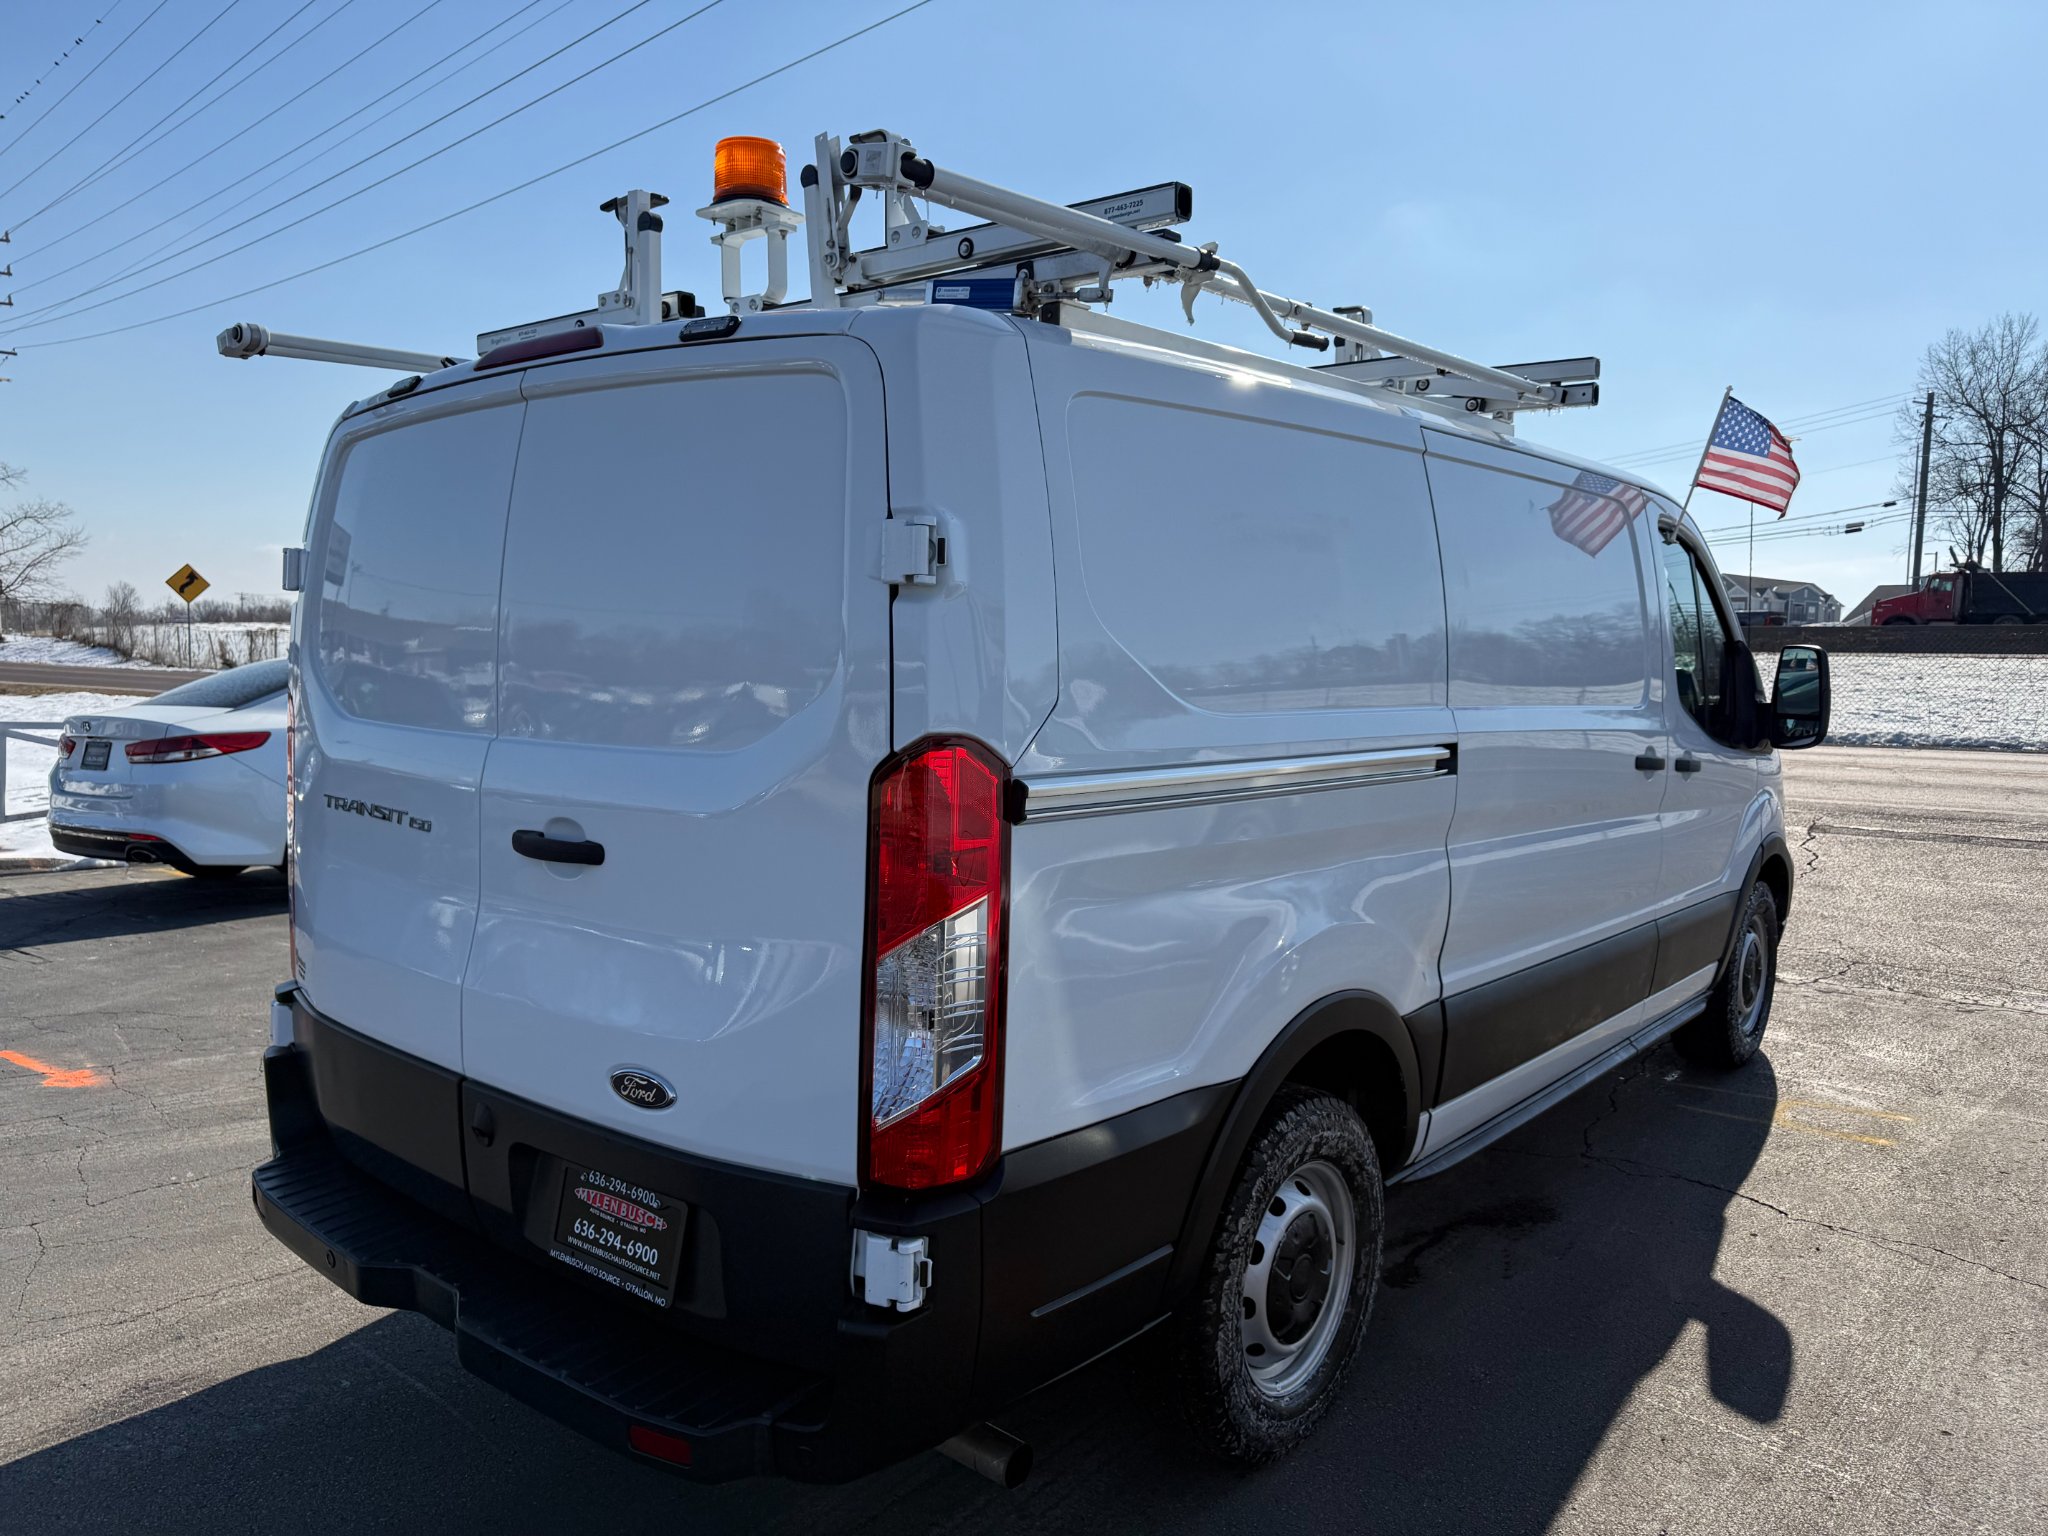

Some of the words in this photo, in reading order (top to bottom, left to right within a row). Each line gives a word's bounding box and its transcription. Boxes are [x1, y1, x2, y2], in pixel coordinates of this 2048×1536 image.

[323, 793, 408, 825] TRANSIT
[620, 1076, 657, 1103] Ford
[577, 1187, 664, 1231] MYLENBUSCH
[589, 1170, 655, 1207] 636-294-6900
[567, 1235, 661, 1281] WWW.MYLENBUSCHAUTOSOURCE.NET
[574, 1218, 658, 1266] 636-294-6900
[549, 1249, 584, 1270] MYLENBUSCH
[583, 1263, 598, 1276] AUTO
[598, 1269, 621, 1287] SOURCE
[654, 1296, 666, 1307] MO
